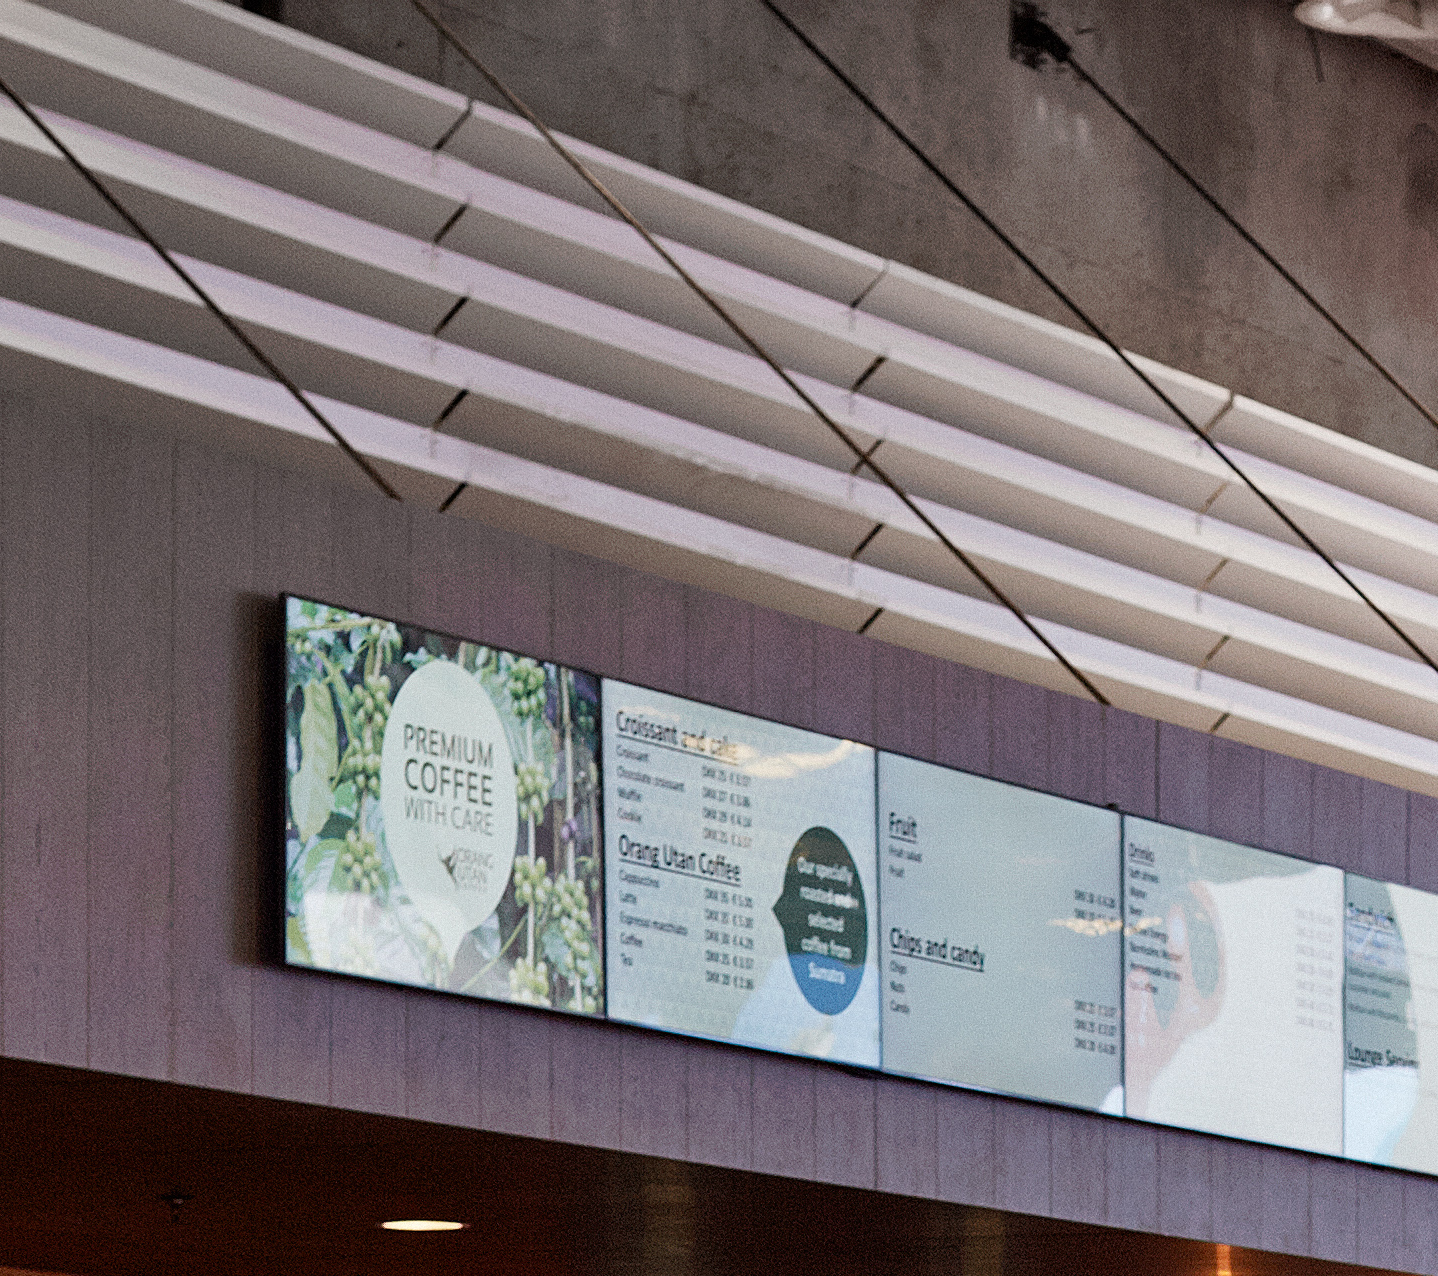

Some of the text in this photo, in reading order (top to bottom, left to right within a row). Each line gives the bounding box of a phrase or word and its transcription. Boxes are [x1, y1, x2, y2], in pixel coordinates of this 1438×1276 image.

[403, 723, 493, 768] PREMIUM
[616, 710, 678, 745] Croissant
[681, 729, 706, 752] and
[404, 758, 493, 807] COFFEE
[404, 796, 493, 837] WITH CARE
[889, 811, 917, 838] Fruit
[618, 834, 741, 882] Orang Utan Coffee
[890, 927, 986, 971] Chips and candy
